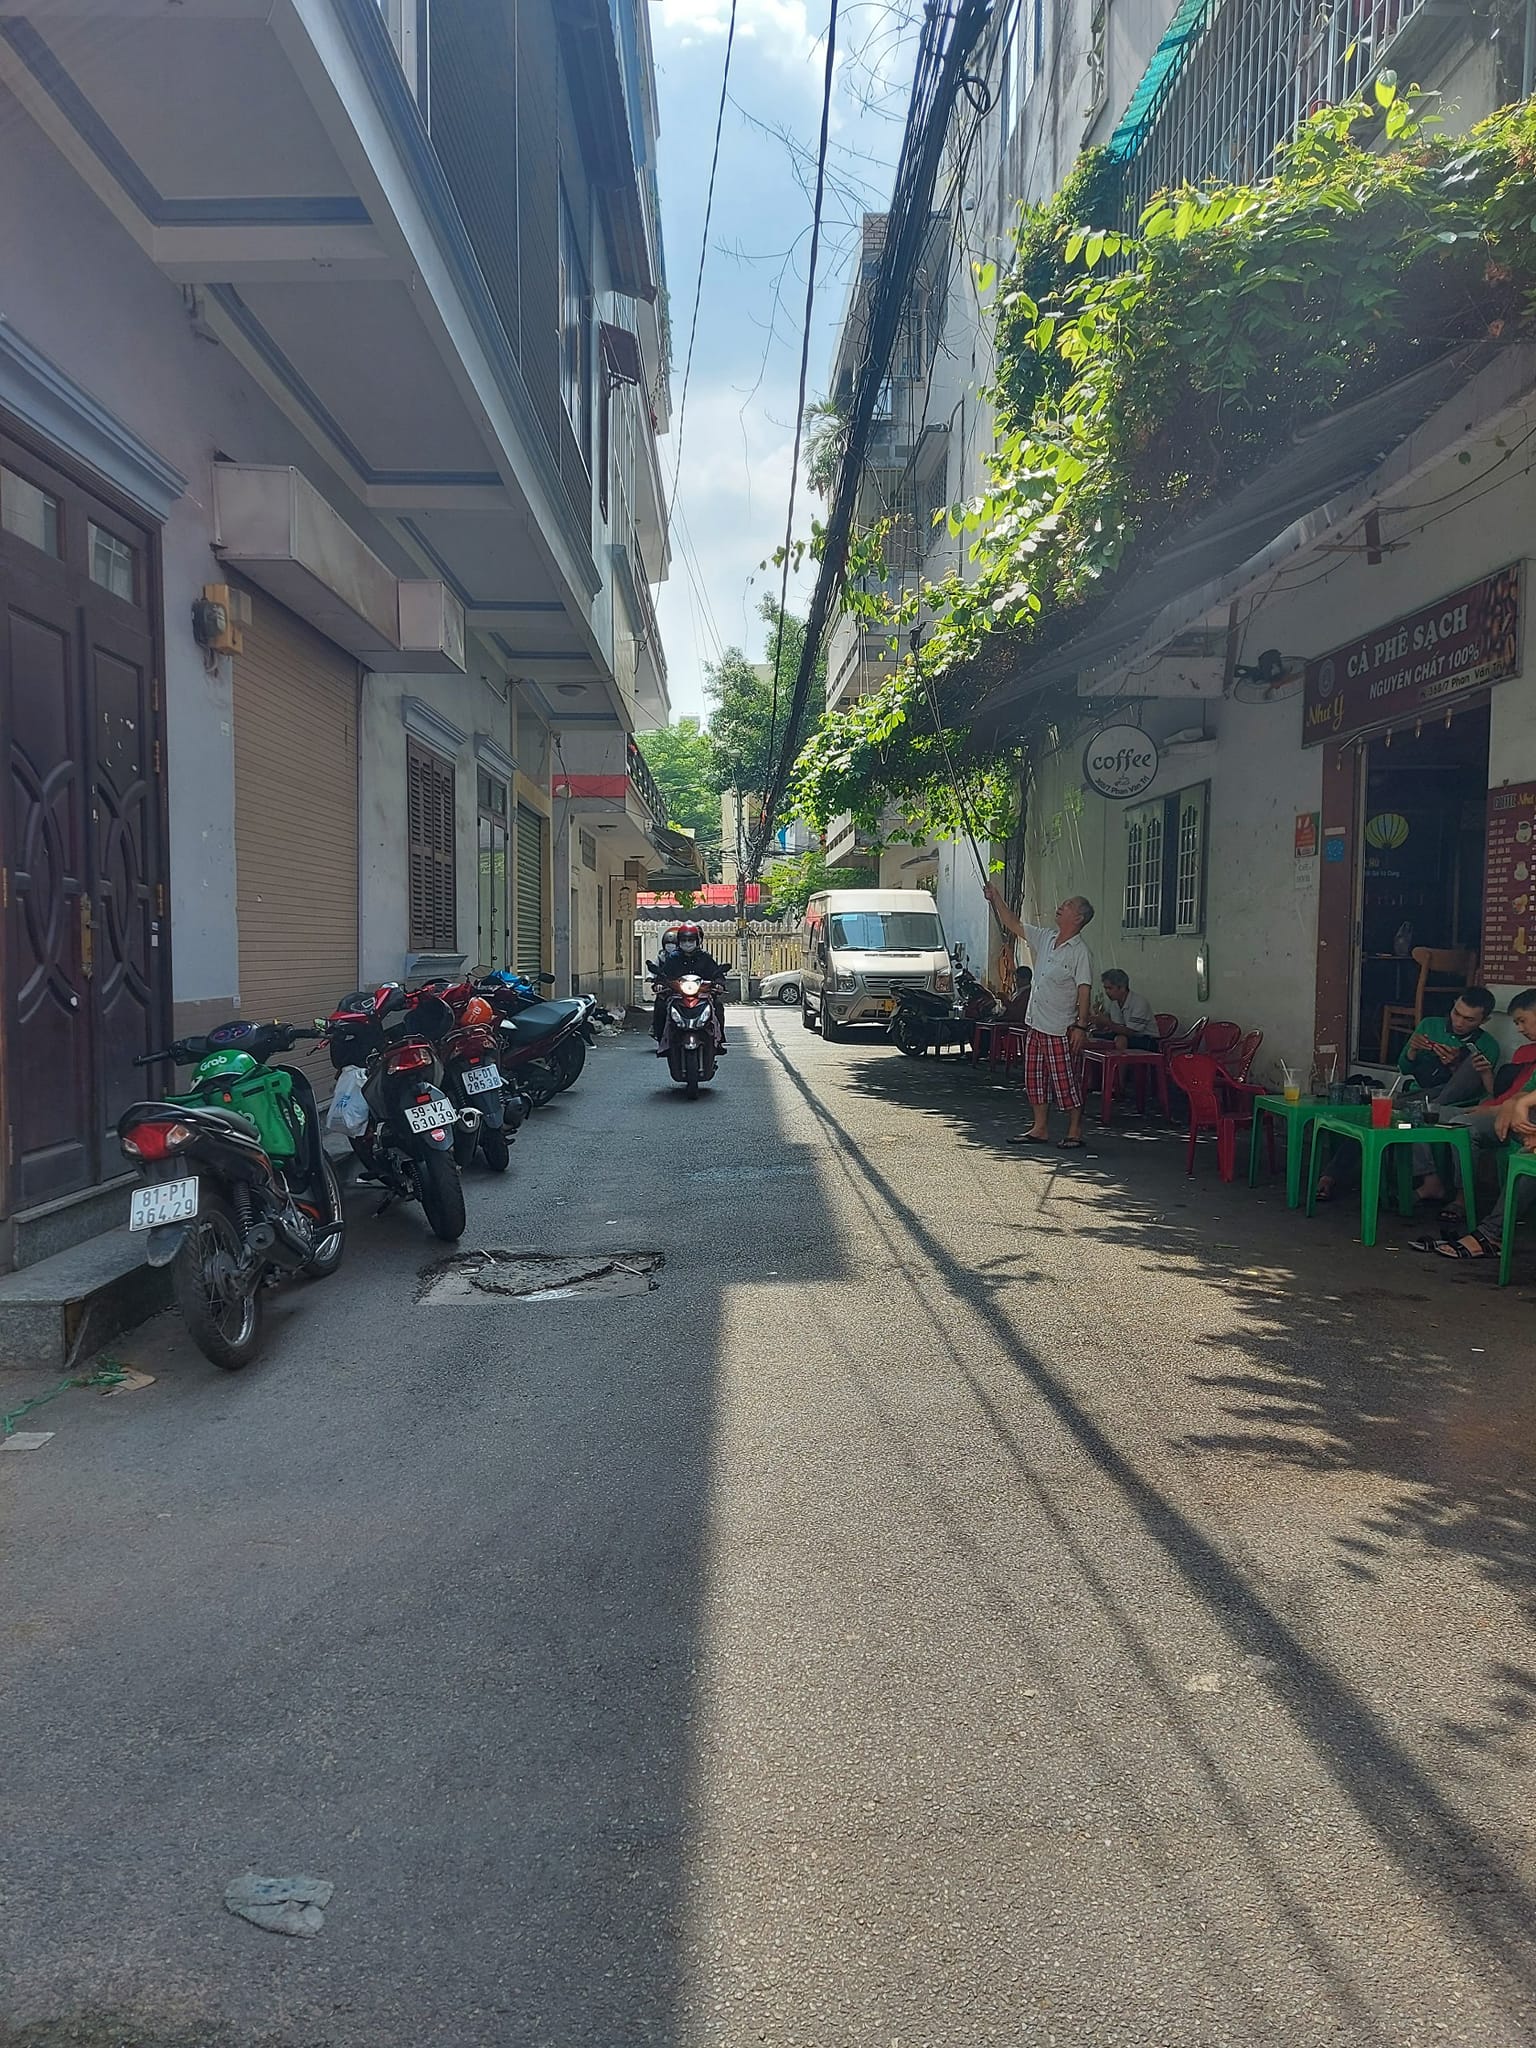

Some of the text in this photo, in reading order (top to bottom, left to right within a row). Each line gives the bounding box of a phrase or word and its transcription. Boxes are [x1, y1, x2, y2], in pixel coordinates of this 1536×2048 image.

[1347, 604, 1468, 678] CÀ PHÊ SẠCH
[1368, 668, 1413, 700] NGUYÊN
[1415, 650, 1445, 683] CHẤT
[1448, 642, 1480, 670] 100%
[1451, 675, 1470, 688] Phan
[1306, 689, 1344, 732] Như Ý
[1093, 748, 1151, 772] coffee
[1111, 786, 1128, 795] Phan
[200, 1056, 228, 1071] Grab
[467, 1076, 498, 1094] 285.38
[411, 1101, 446, 1119] 59-V2
[412, 1110, 454, 1131] 630.39
[143, 1182, 186, 1207] 81-P1
[135, 1199, 193, 1226] 364.29
